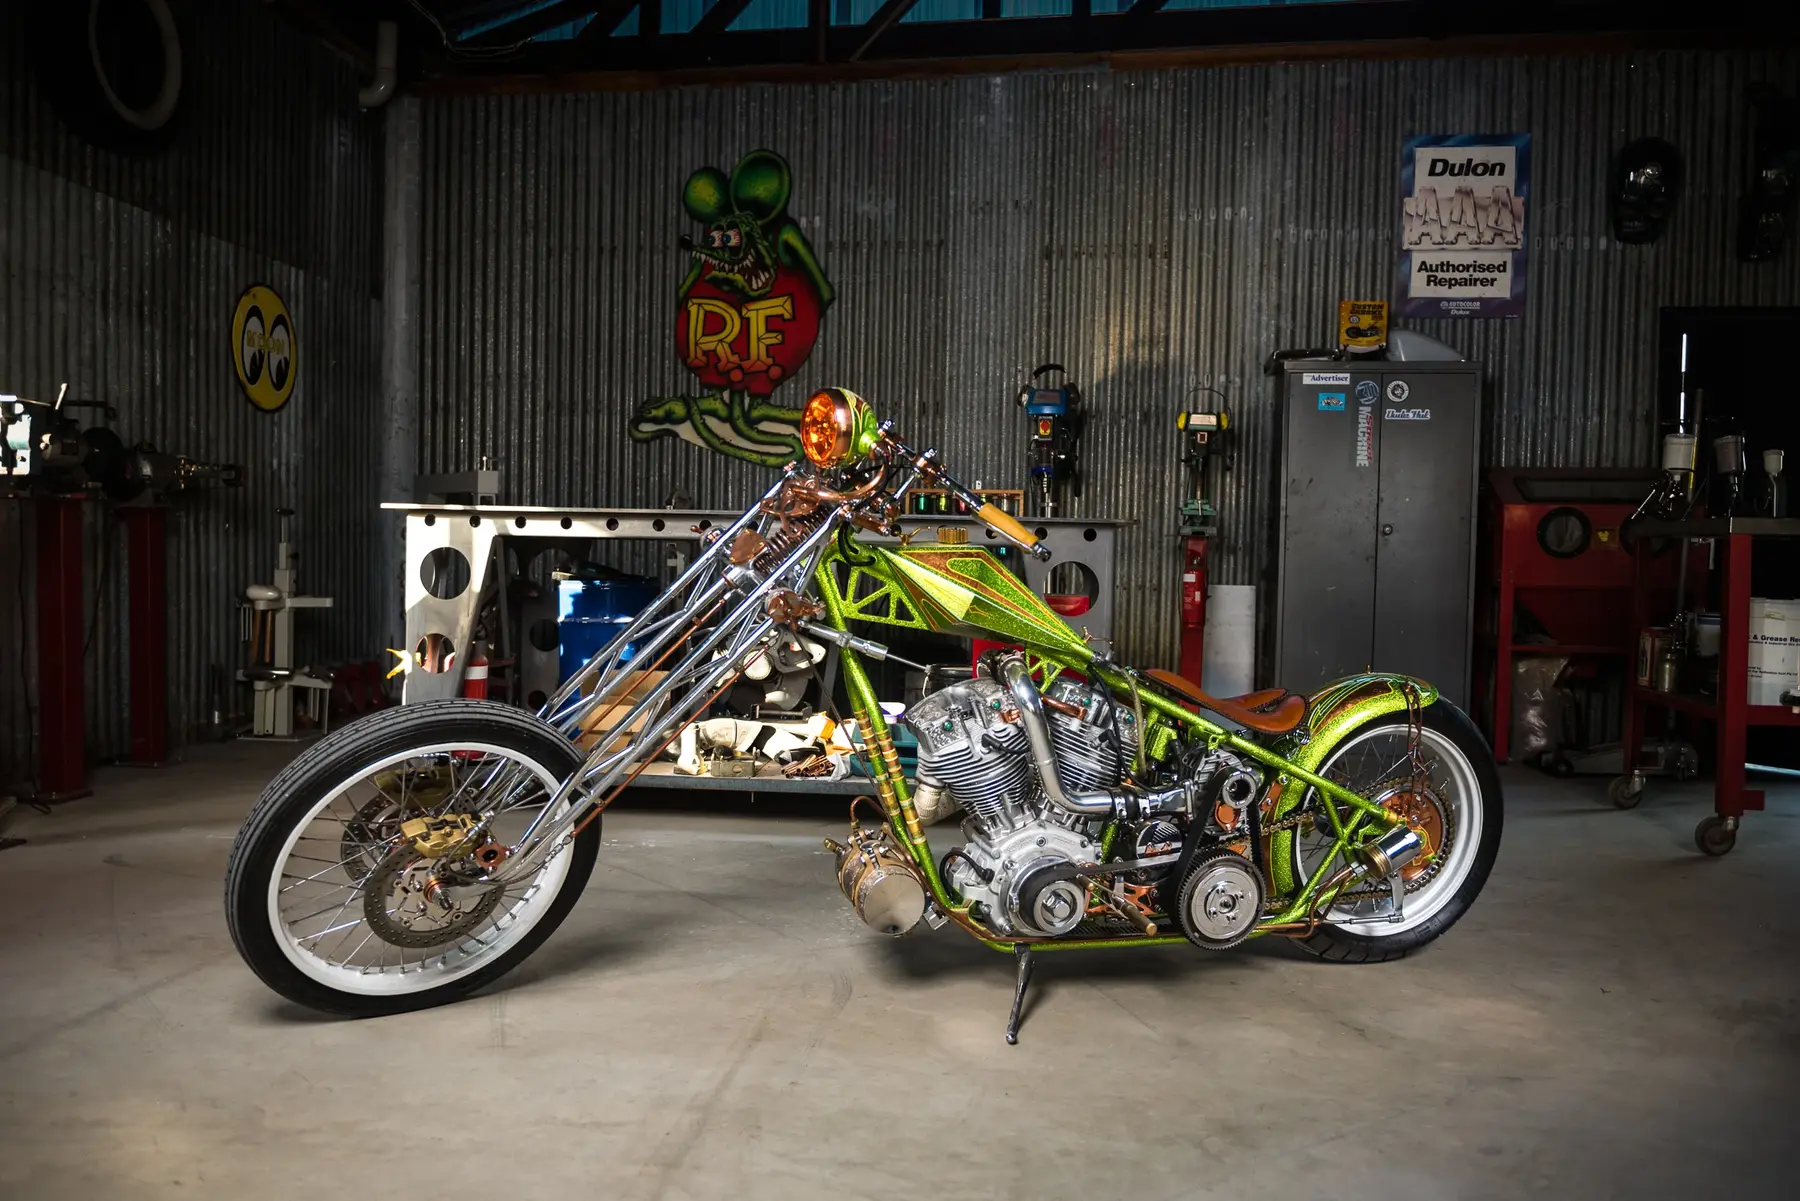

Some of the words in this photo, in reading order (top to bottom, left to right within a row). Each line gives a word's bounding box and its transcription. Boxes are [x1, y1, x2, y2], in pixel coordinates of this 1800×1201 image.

[1427, 158, 1506, 177] Dulon
[1407, 185, 1519, 246] AAA
[1417, 260, 1507, 273] Authorised
[1426, 274, 1497, 289] Repairer
[246, 330, 285, 356] MOON
[1311, 374, 1349, 382] Advertiser
[1356, 406, 1371, 467] MACHINE
